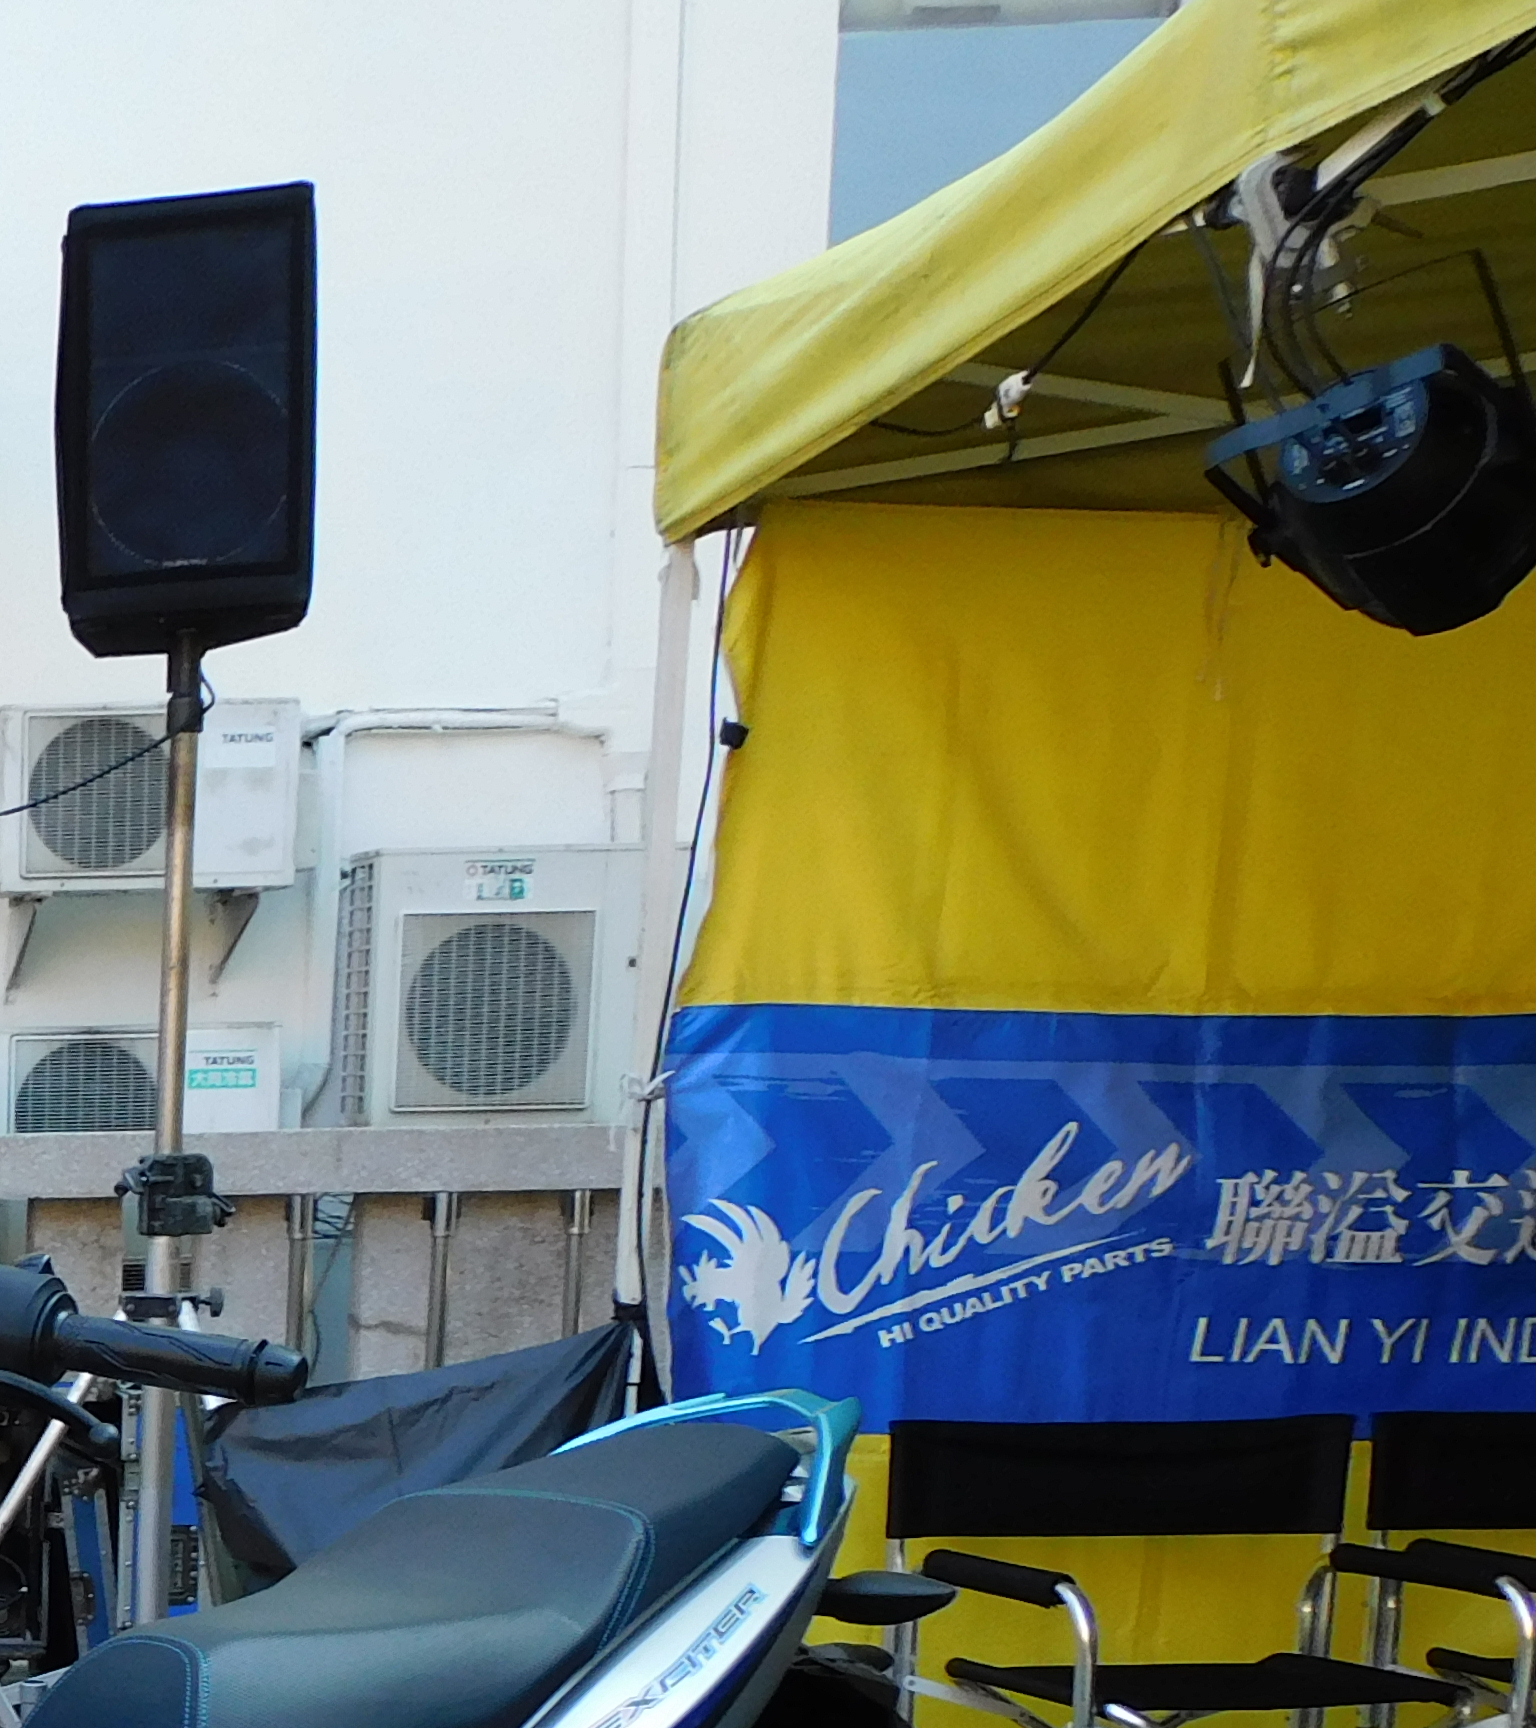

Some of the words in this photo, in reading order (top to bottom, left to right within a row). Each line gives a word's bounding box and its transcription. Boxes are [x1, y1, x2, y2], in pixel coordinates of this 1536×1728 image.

[817, 1121, 1192, 1315] Chicken
[877, 1320, 914, 1349] HI
[918, 1271, 1052, 1333] QUALITY
[1062, 1237, 1175, 1284] PARTS
[1189, 1316, 1351, 1365] LIAN
[1370, 1316, 1430, 1364] YI
